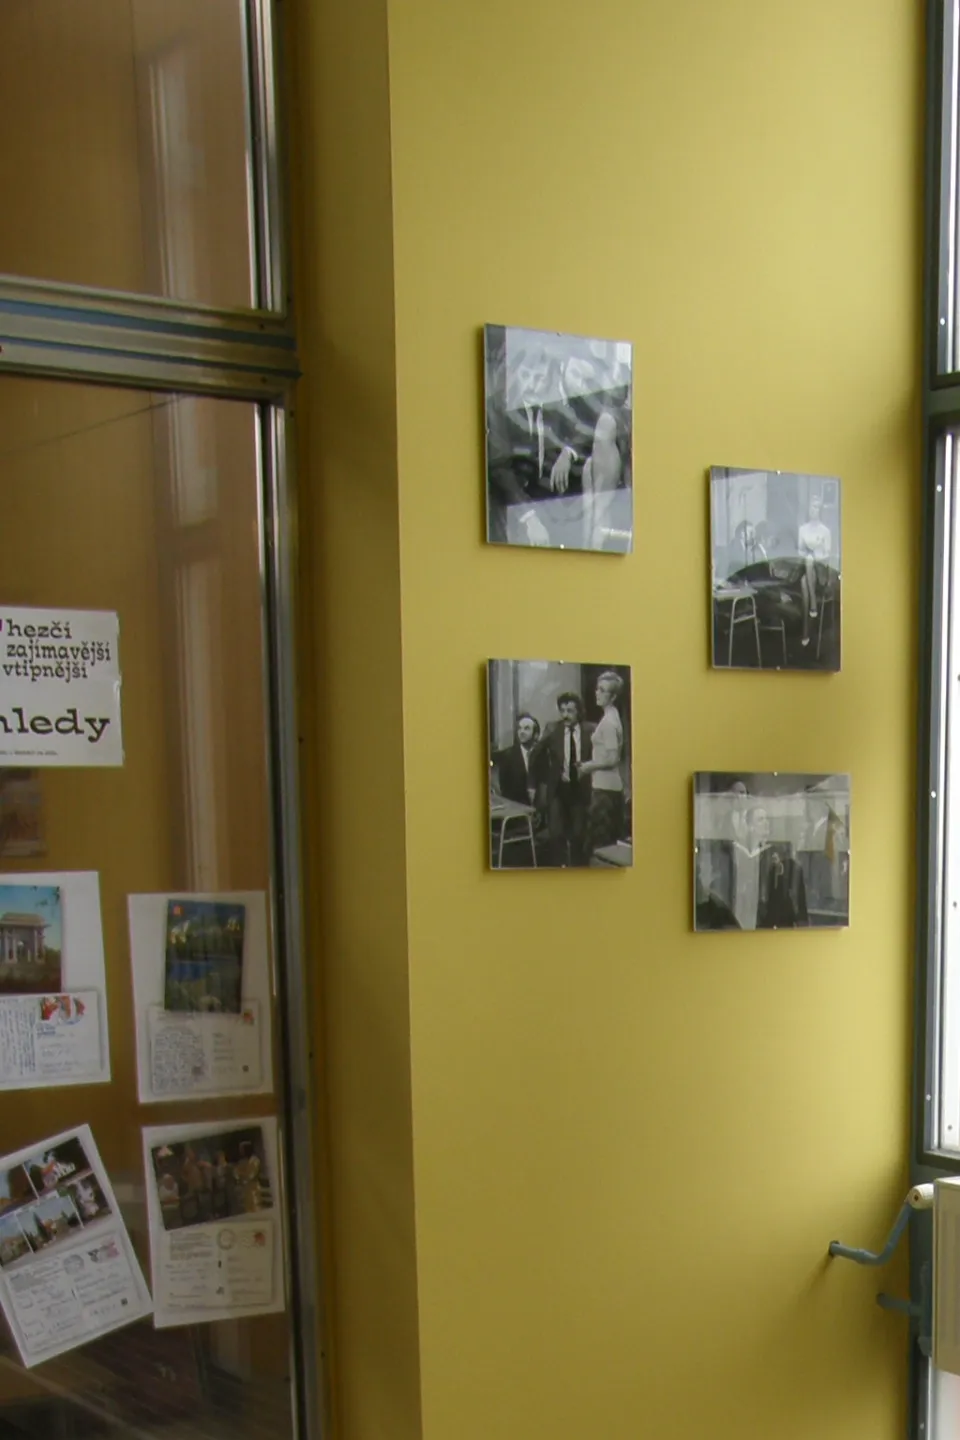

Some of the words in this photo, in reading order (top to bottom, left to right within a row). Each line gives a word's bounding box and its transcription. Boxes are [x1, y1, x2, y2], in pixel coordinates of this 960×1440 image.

[6, 618, 72, 640] hezčí
[6, 639, 111, 666] zajímavější
[3, 660, 88, 683] vtipnější
